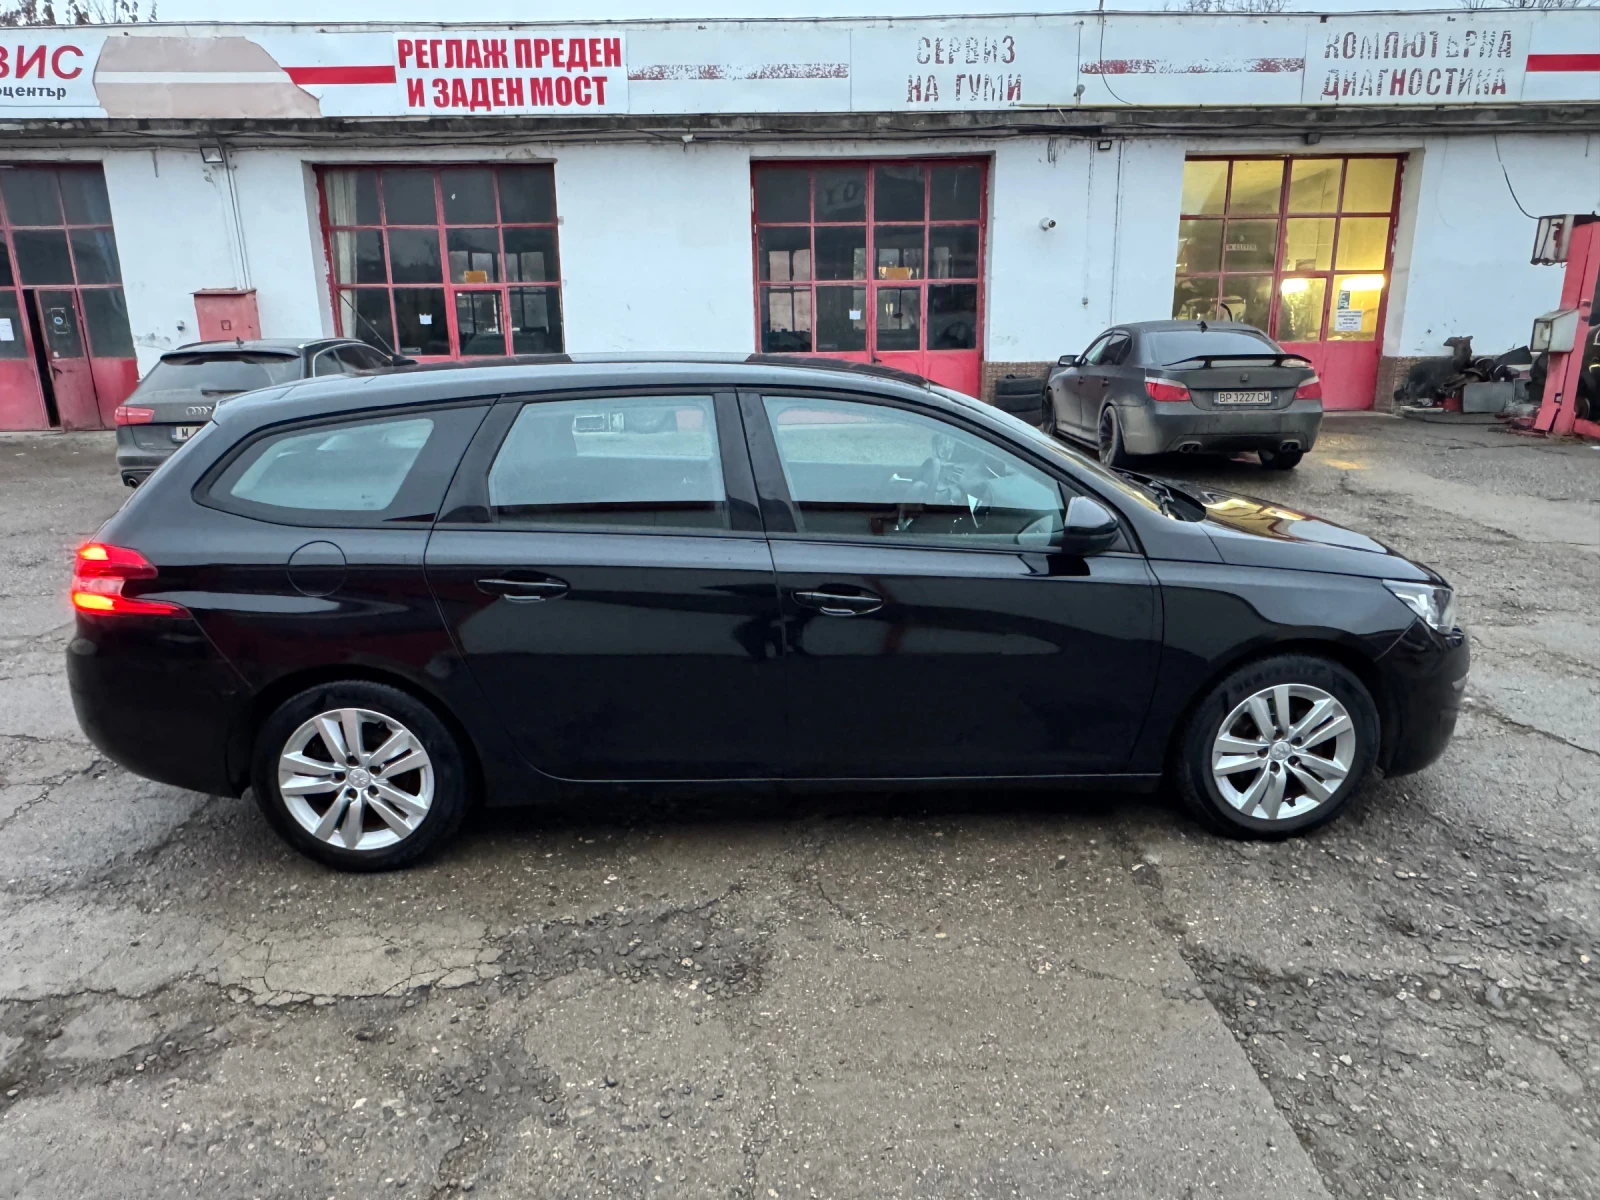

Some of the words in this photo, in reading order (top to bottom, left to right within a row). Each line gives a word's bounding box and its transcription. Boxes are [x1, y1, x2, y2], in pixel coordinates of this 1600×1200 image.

[397, 39, 509, 69] РЕГЛАЖ
[514, 38, 622, 72] ПРЕДЕН
[917, 35, 1015, 64] СЕРВИЗ
[0, 86, 67, 100] център
[407, 78, 425, 107] И
[432, 77, 524, 112] ЗАДЕН
[530, 75, 608, 106] МОСТ
[906, 74, 939, 102] НА
[955, 74, 1021, 101] ГУМИ
[1320, 68, 1507, 100] ДИАГНОСТИКА
